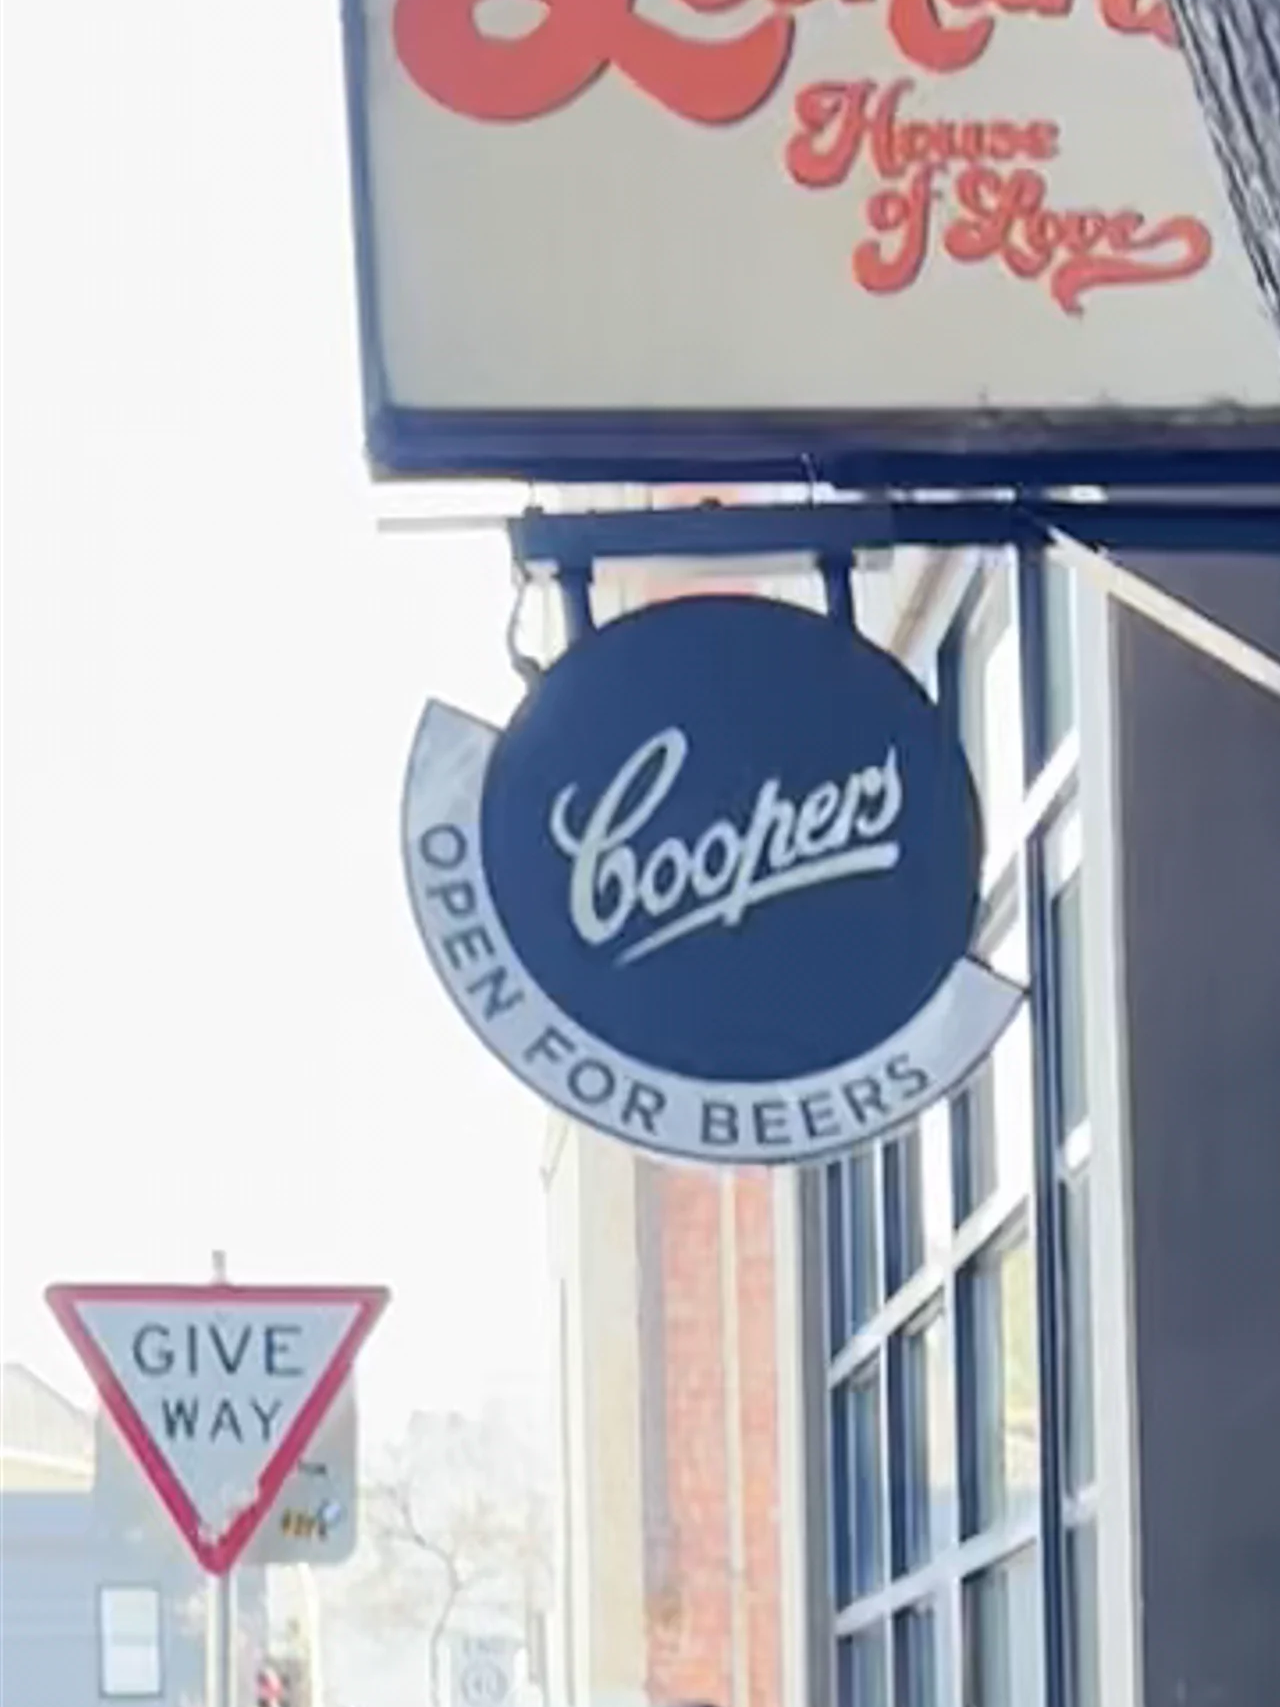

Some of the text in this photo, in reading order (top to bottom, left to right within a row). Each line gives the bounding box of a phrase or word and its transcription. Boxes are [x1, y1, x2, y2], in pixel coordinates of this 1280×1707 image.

[785, 78, 1060, 189] House
[852, 161, 1213, 319] of Love
[549, 726, 904, 947] Coopers
[418, 822, 932, 1147] OPEN FOR BEERS
[131, 1322, 305, 1378] GIVE
[160, 1397, 283, 1445] WAY
